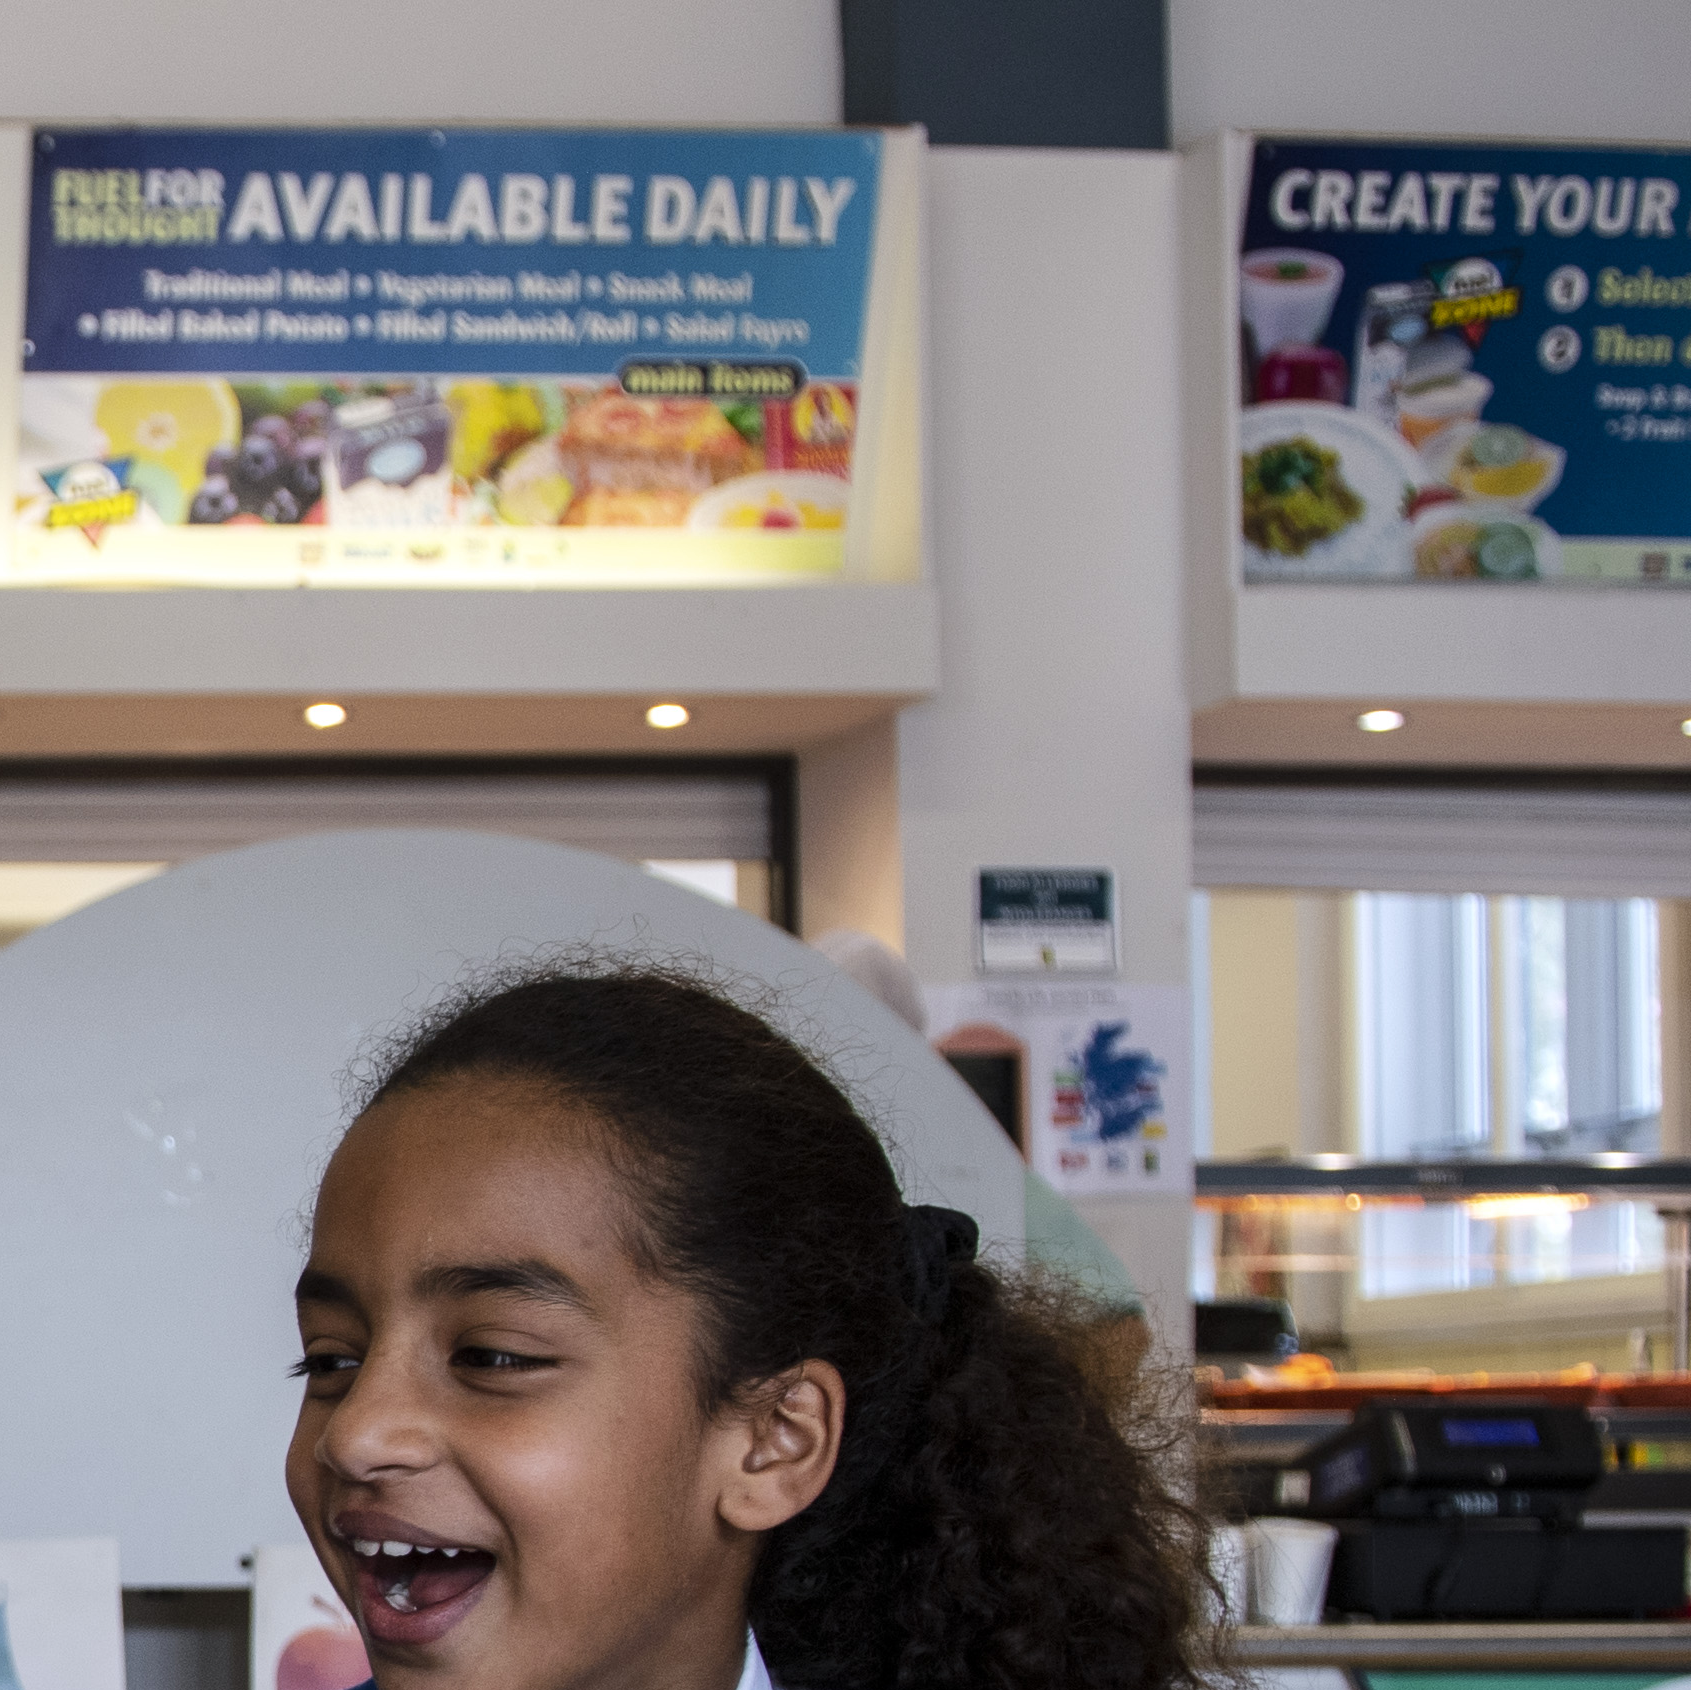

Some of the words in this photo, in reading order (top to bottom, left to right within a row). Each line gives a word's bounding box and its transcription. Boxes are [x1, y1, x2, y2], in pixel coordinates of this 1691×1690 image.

[227, 171, 634, 245] AVAILABLE
[645, 174, 857, 247] DAILY
[1270, 167, 1500, 234] CREATE
[1514, 174, 1679, 238] YOUR
[145, 268, 282, 301] Traditional
[285, 268, 350, 301] Meal
[374, 268, 514, 307] Vegetarian
[519, 269, 581, 302] Meal
[607, 270, 685, 302] Snack
[689, 271, 753, 302] Meal
[1597, 265, 1691, 308] Selec
[100, 307, 174, 342] Filled
[178, 307, 260, 342] Baked
[262, 308, 351, 343] Potato
[375, 308, 448, 343] Filled
